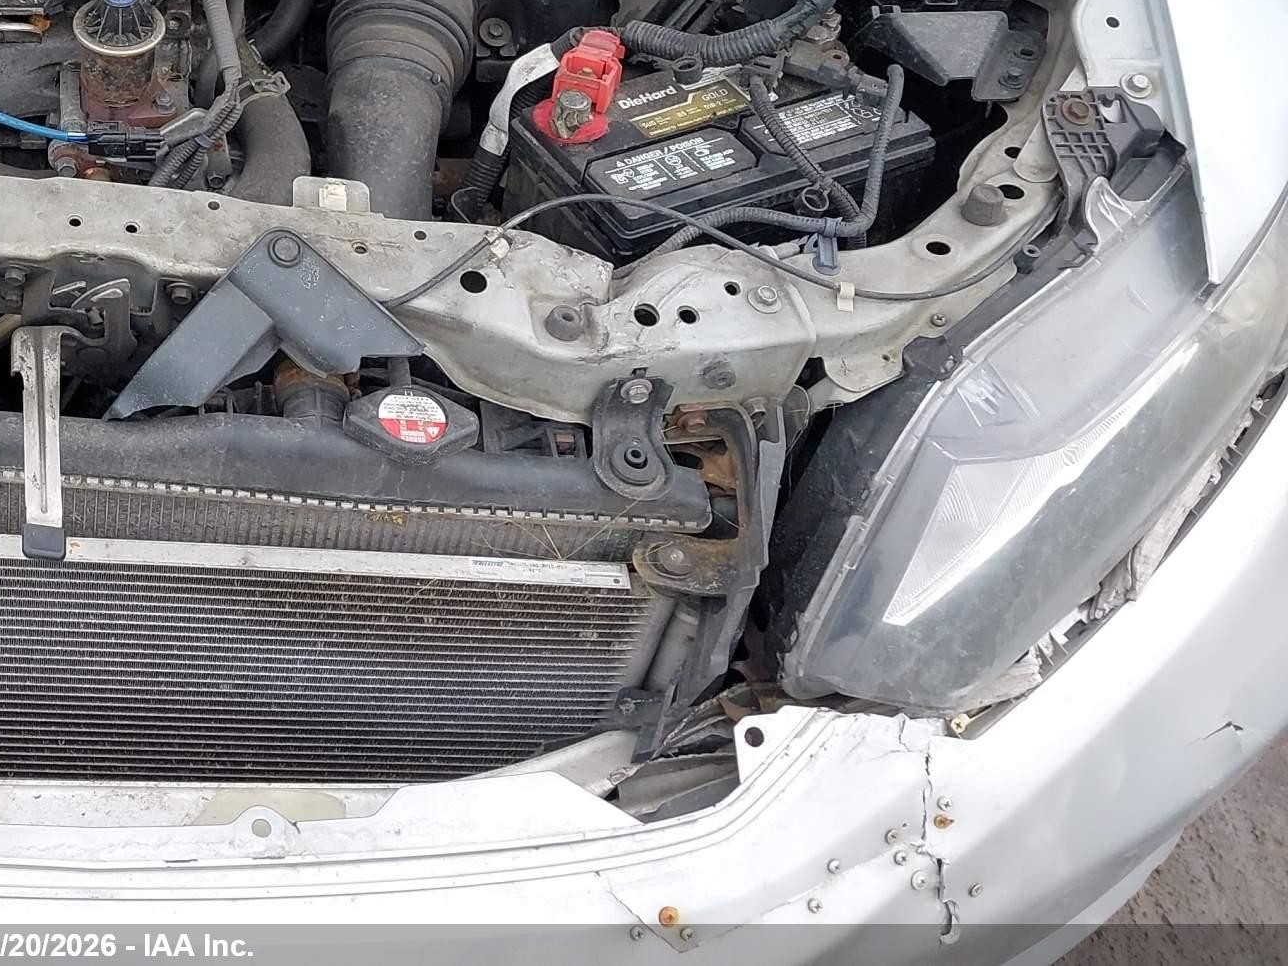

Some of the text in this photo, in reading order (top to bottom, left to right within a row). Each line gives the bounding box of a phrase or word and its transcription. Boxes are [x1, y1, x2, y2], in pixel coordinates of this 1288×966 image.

[617, 85, 677, 110] DieHard
[701, 88, 729, 101] GOLD
[625, 149, 663, 165] DANGER
[669, 137, 705, 152] POISON
